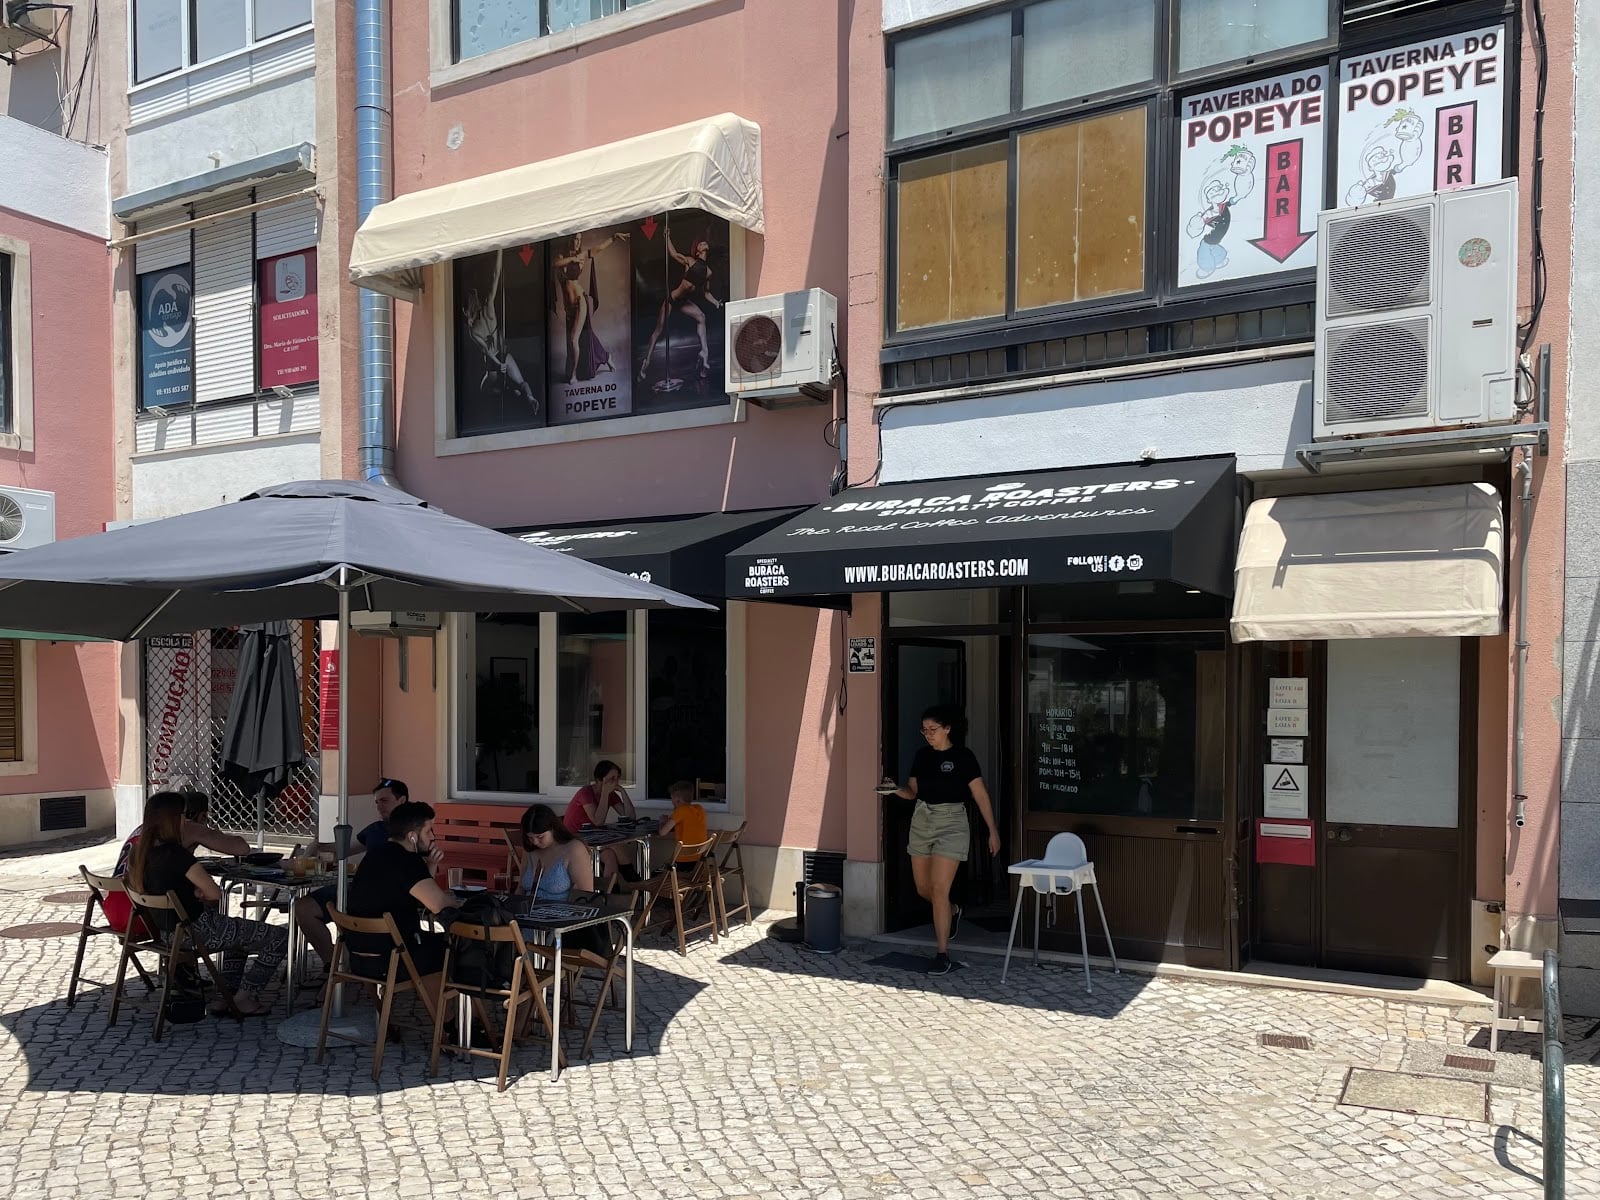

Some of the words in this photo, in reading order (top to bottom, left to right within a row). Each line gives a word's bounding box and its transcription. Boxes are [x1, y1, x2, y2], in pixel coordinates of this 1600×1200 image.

[1347, 41, 1456, 79] TAVERNA
[1464, 32, 1498, 55] DO
[1346, 55, 1498, 113] POPEYE
[1188, 82, 1285, 117] TAVERNA
[1291, 74, 1322, 96] DO
[1187, 95, 1322, 148] POPEYE
[1446, 115, 1464, 185] BAR
[1275, 151, 1291, 217] BAR
[158, 301, 178, 316] ADA
[272, 308, 310, 321] SOLICITADORA
[564, 385, 603, 398] TAVERNA
[605, 383, 617, 392] DO
[565, 396, 617, 414] POPEYE
[831, 494, 973, 513] BURACA
[979, 478, 1181, 504] ROASTERS
[877, 501, 1002, 517] SPECIALTY
[1003, 495, 1097, 509] COFFEE
[786, 526, 832, 537] The
[835, 521, 899, 535] Real
[899, 517, 980, 531] Coffee
[749, 564, 785, 576] BURACA
[844, 558, 1029, 584] WWW.BURACAROASTERS.COM
[1067, 555, 1104, 567] FOLLOW
[1091, 564, 1104, 573] US
[745, 575, 790, 588] ROASTERS
[151, 637, 181, 647] ESCOLA
[154, 651, 192, 774] CONDUÇÃO
